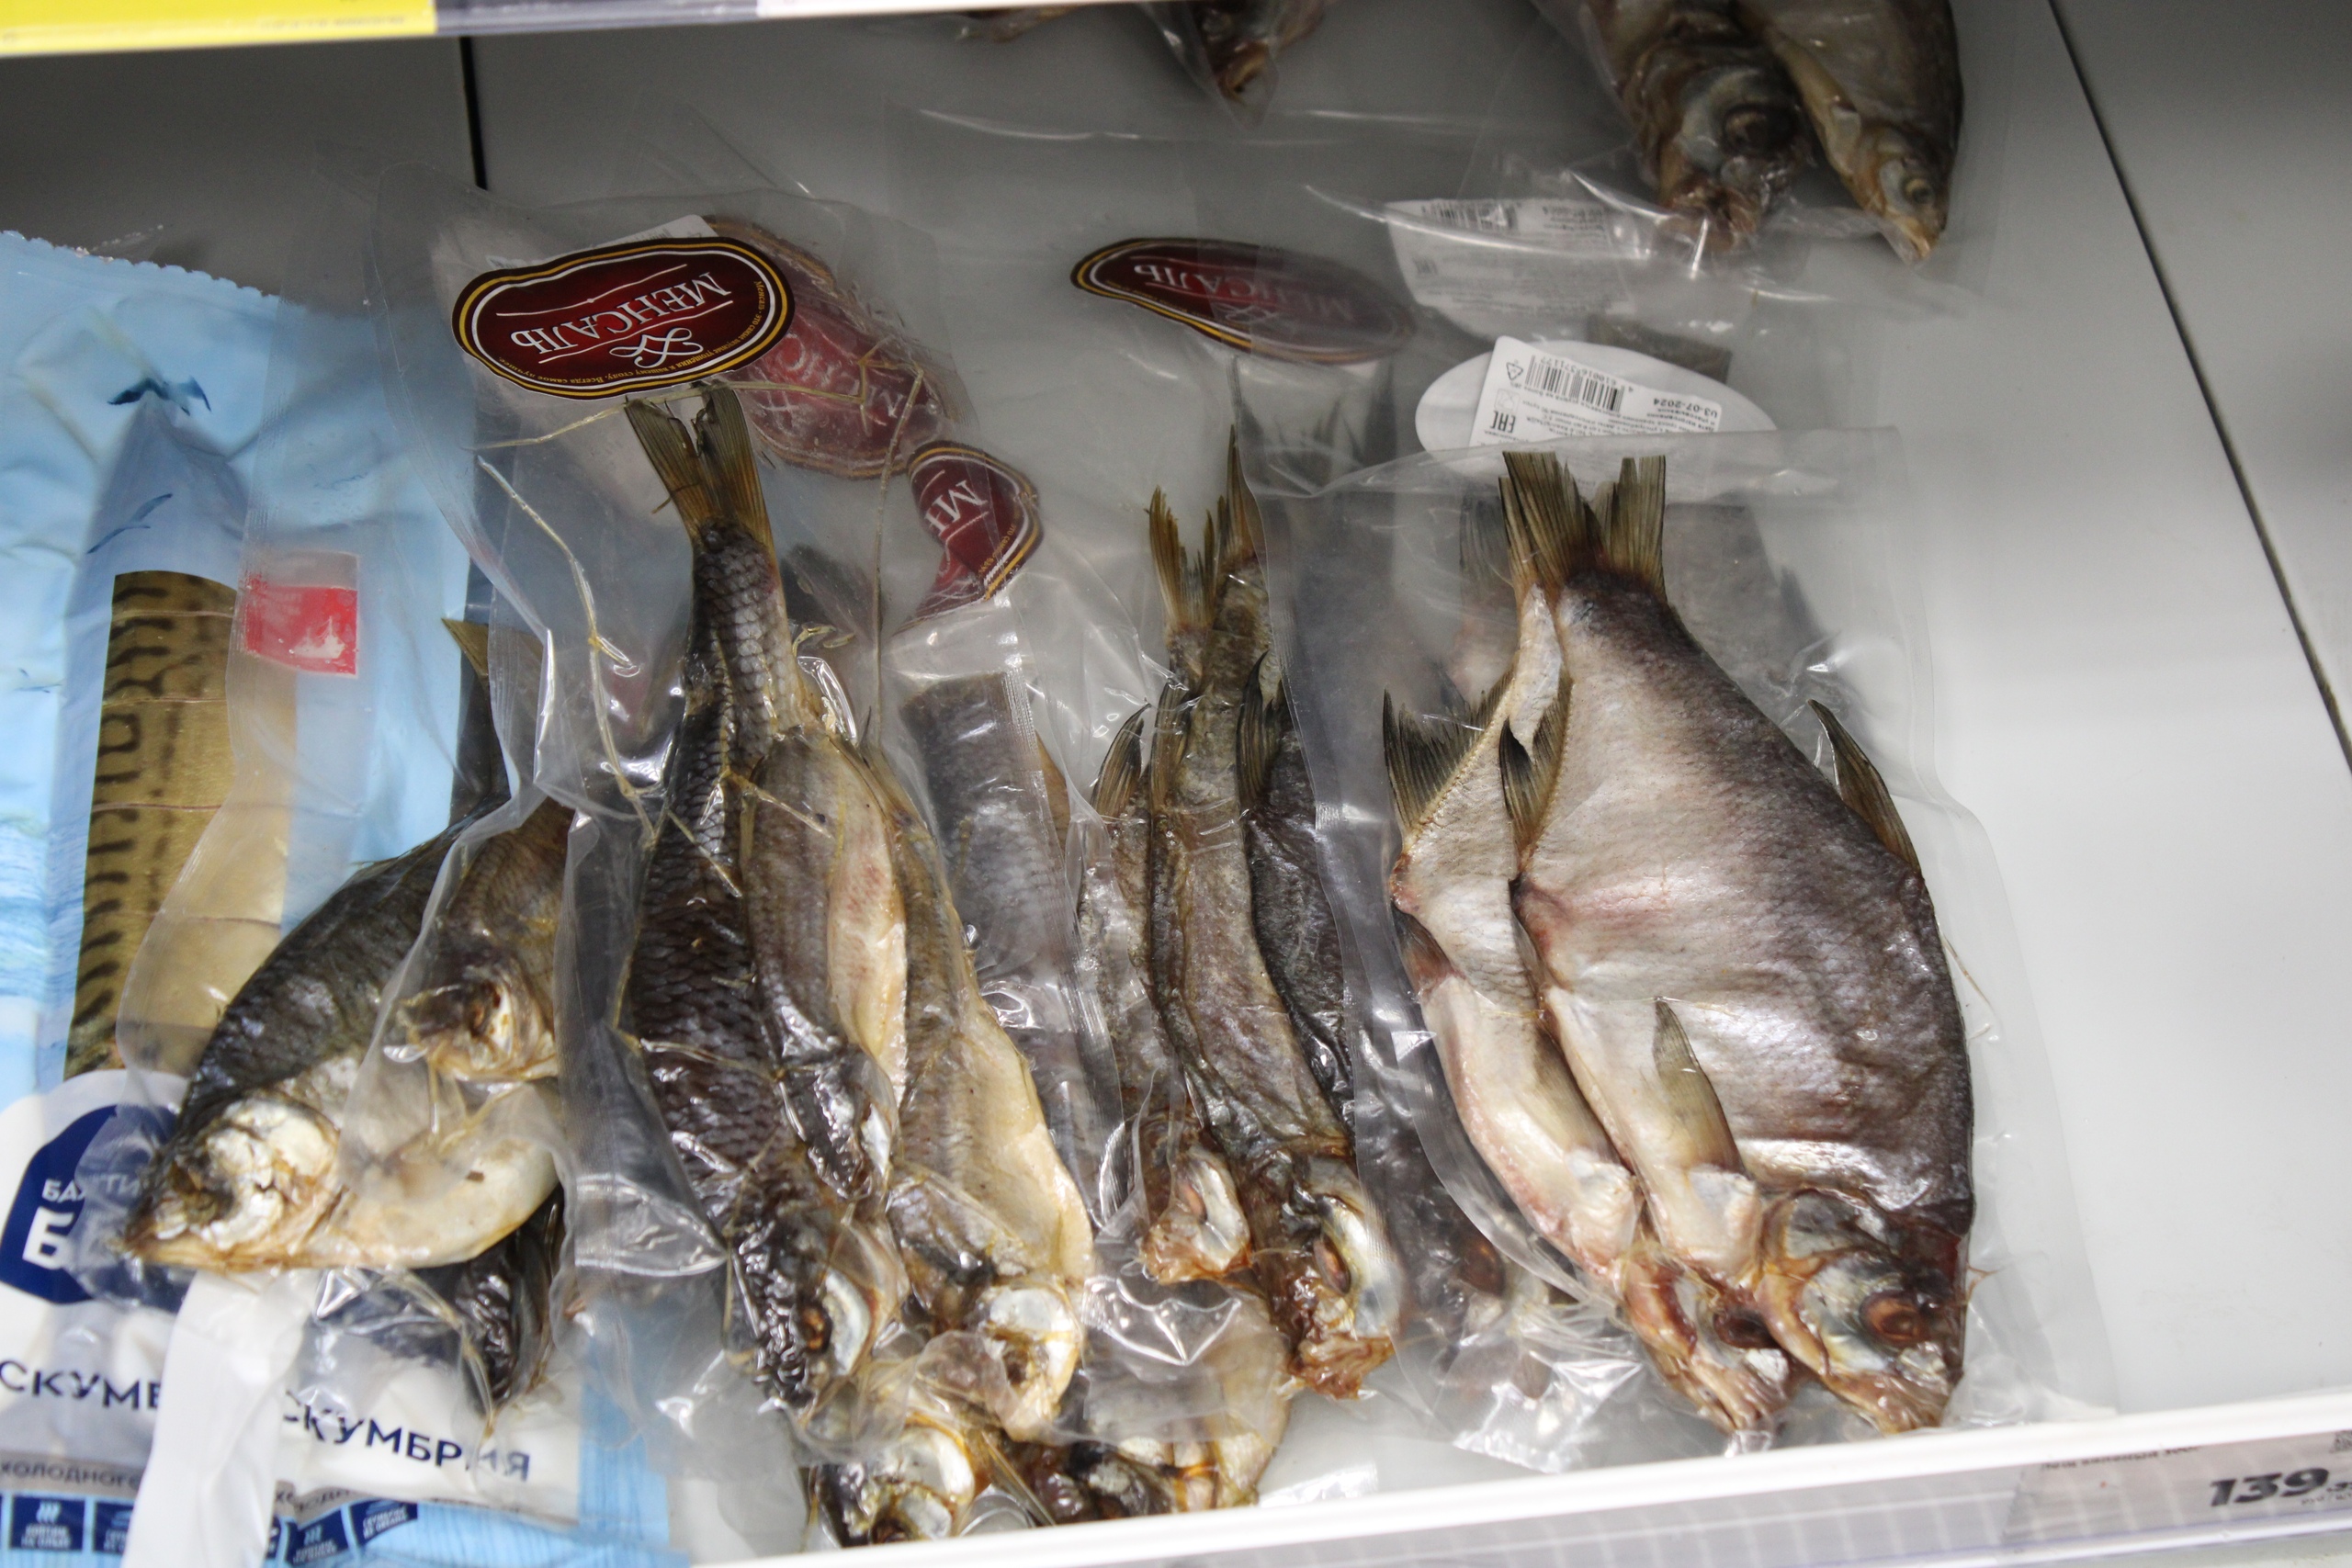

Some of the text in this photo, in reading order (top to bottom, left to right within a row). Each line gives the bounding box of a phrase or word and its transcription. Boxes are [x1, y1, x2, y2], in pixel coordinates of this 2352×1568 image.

[511, 272, 731, 355] МЕНСАЛЬ
[571, 376, 605, 384] Всегда
[2210, 1467, 2330, 1506] 139
